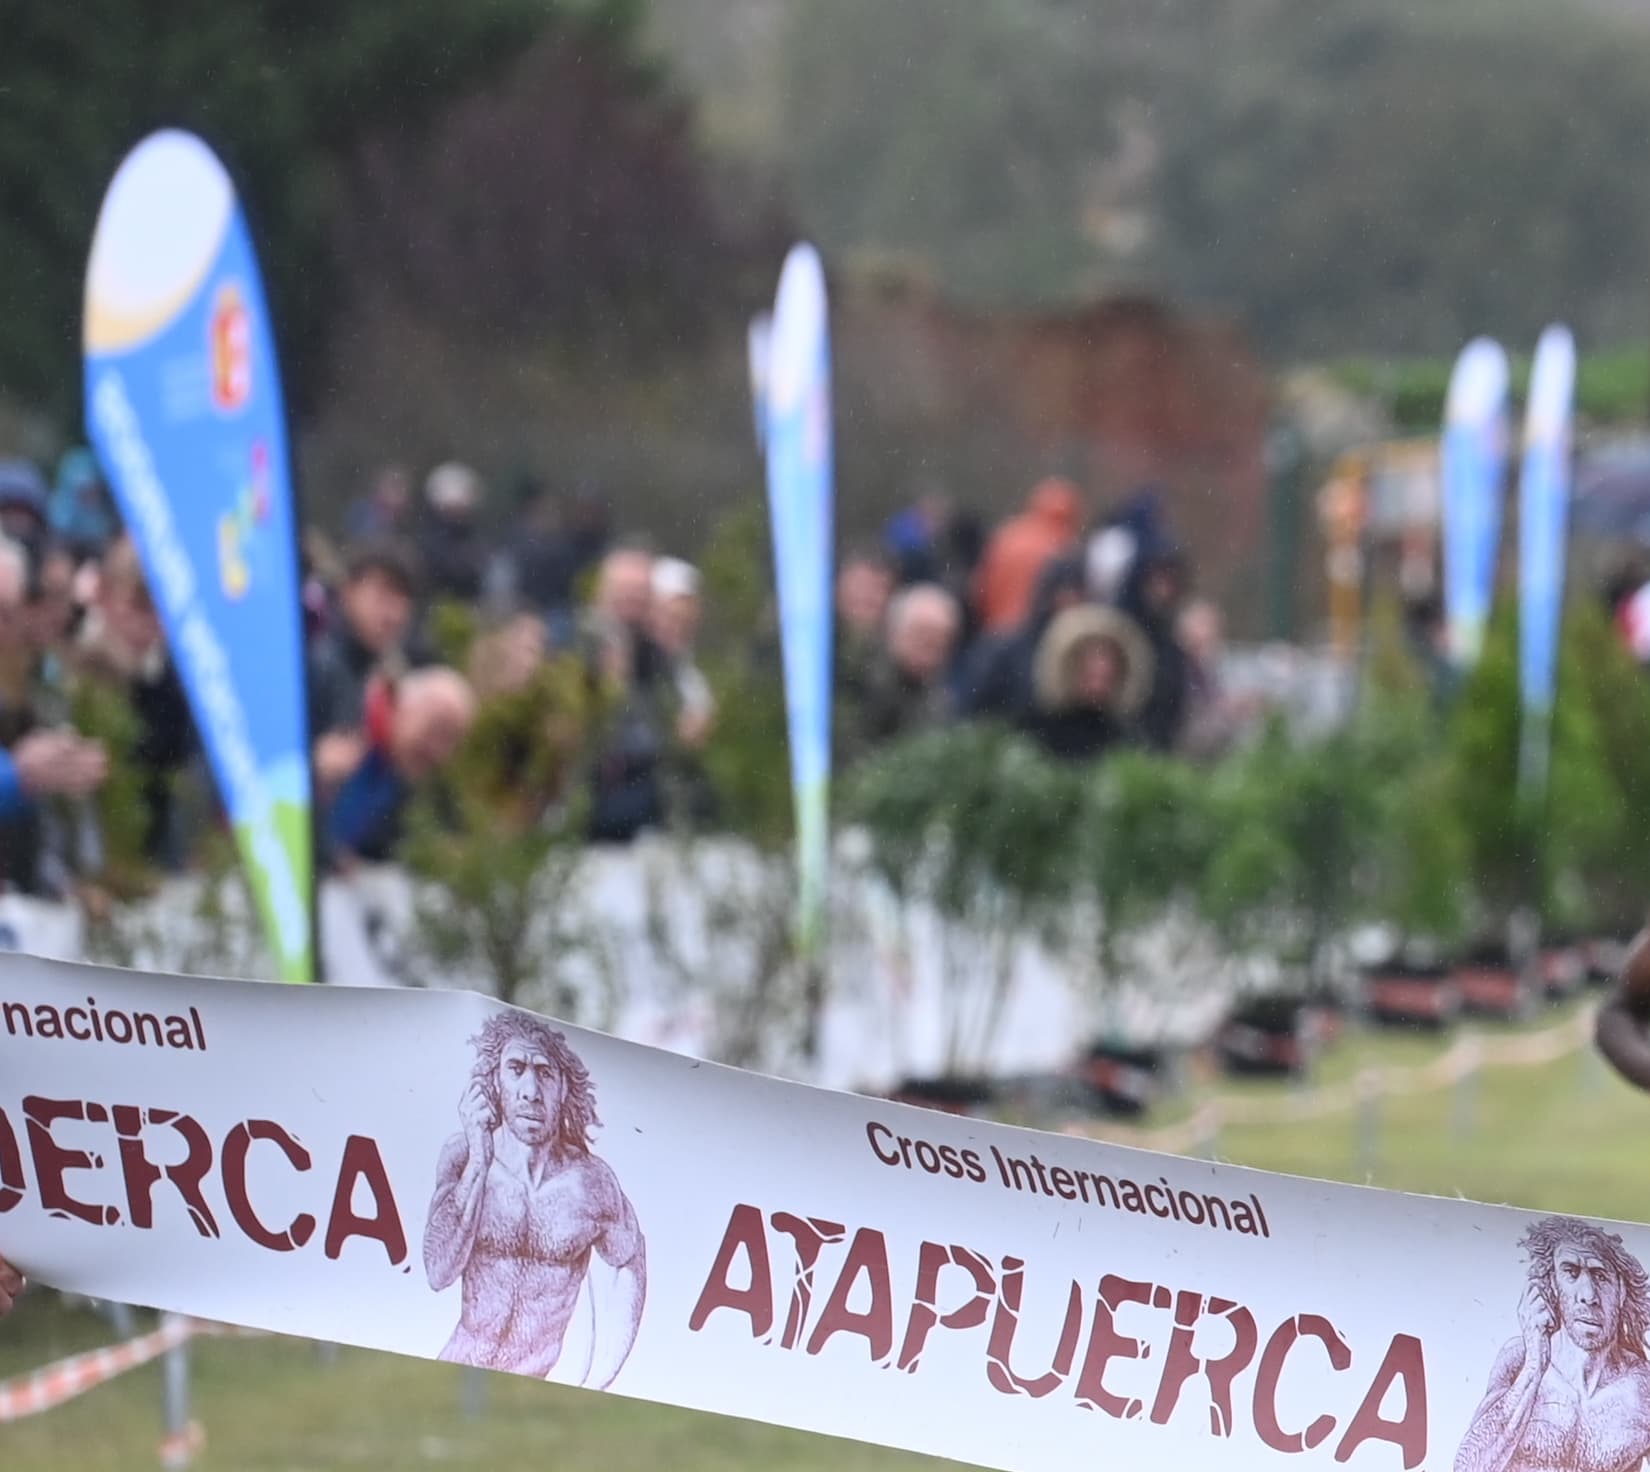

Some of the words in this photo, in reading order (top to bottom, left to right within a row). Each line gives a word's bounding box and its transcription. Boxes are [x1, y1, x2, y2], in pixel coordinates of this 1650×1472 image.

[1, 996, 207, 1051] nacional
[866, 1121, 987, 1184] Cross
[990, 1144, 1270, 1238] Internacional
